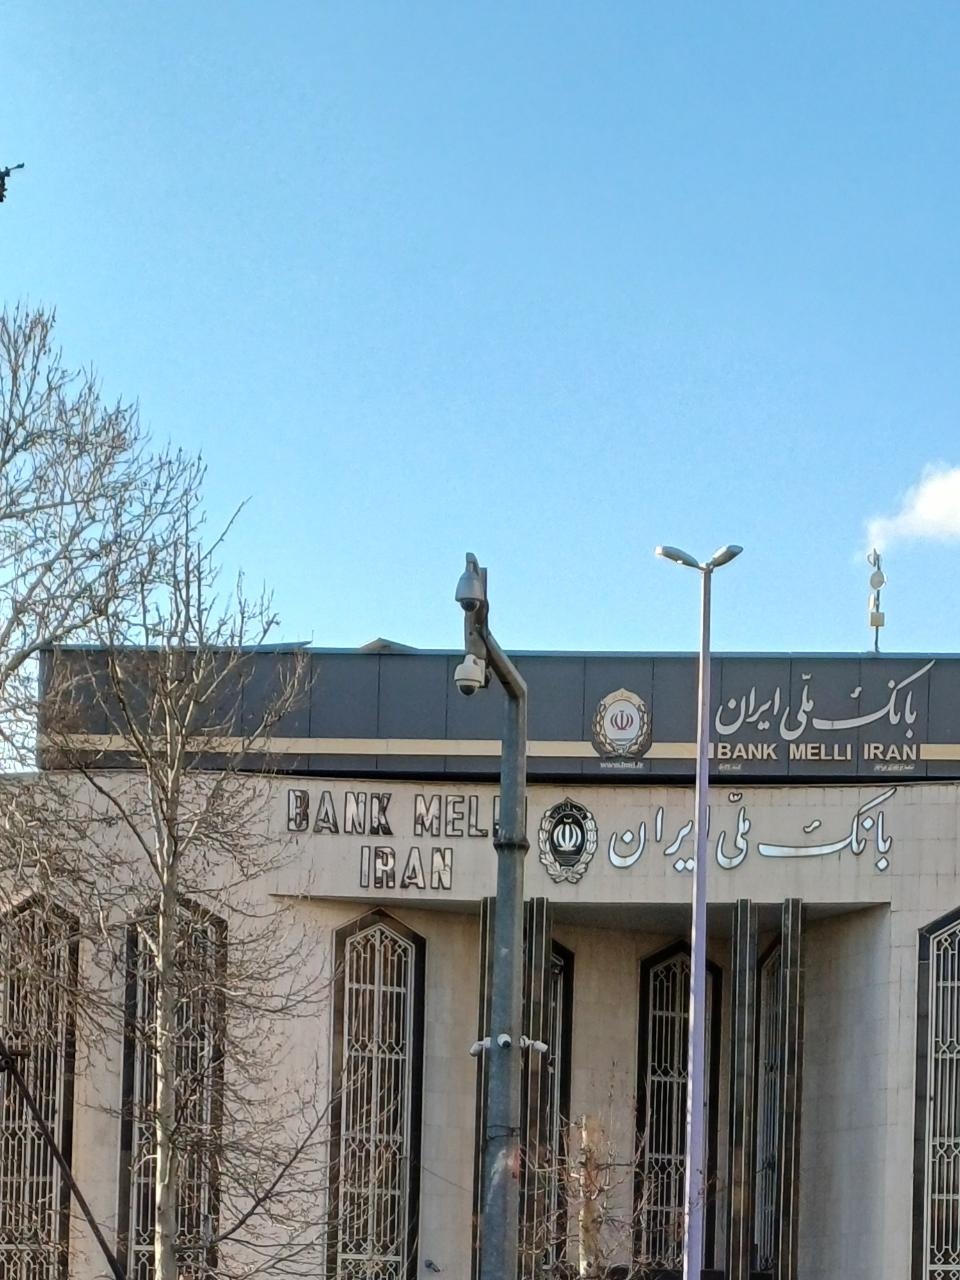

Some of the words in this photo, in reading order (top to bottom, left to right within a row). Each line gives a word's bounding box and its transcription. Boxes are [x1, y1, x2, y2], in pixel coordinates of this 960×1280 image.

[715, 686, 780, 736] ایران
[812, 659, 936, 739] بانک
[717, 743, 778, 760] BANK
[789, 743, 851, 760] MELLI
[864, 743, 917, 760] IRAN
[288, 790, 393, 836] BANK
[758, 786, 897, 871] بانک
[360, 845, 453, 890] IRAN
